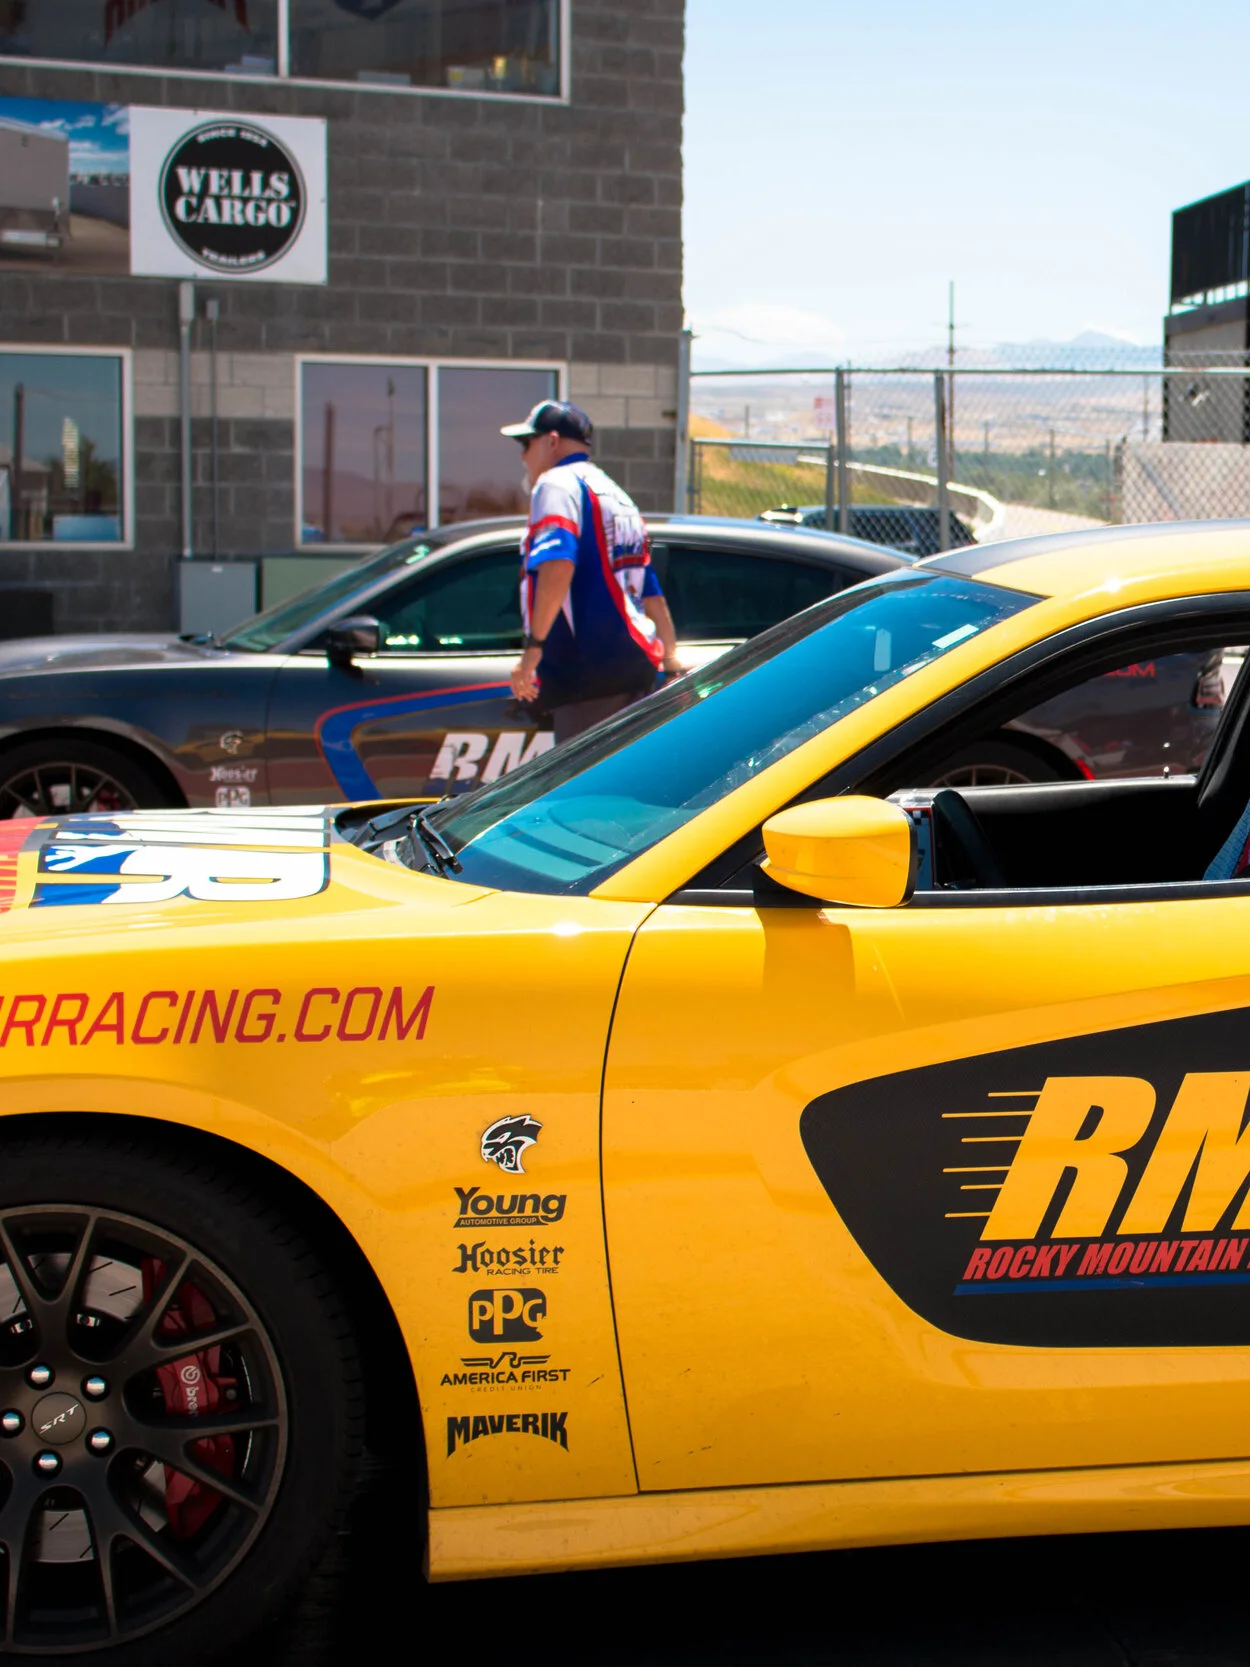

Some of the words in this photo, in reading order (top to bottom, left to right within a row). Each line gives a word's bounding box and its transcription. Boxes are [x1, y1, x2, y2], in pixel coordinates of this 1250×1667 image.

[175, 166, 290, 199] WELLS
[174, 195, 293, 227] CARGO
[0, 986, 435, 1047] RRACING.COM
[453, 1187, 567, 1223] Young
[460, 1218, 508, 1226] AUTOMOTIVE
[509, 1217, 537, 1225] GROUP
[452, 1239, 565, 1274] Hoosier
[486, 1267, 531, 1276] RACING
[535, 1266, 559, 1274] TIRE
[962, 1244, 1079, 1280] ROCKY
[1076, 1237, 1249, 1276] MOUNTAIN
[471, 1289, 543, 1336] PPG
[440, 1371, 519, 1386] AMERICA
[520, 1368, 571, 1383] FIRST
[39, 1404, 79, 1435] SRT
[446, 1411, 570, 1459] MAVERIK
